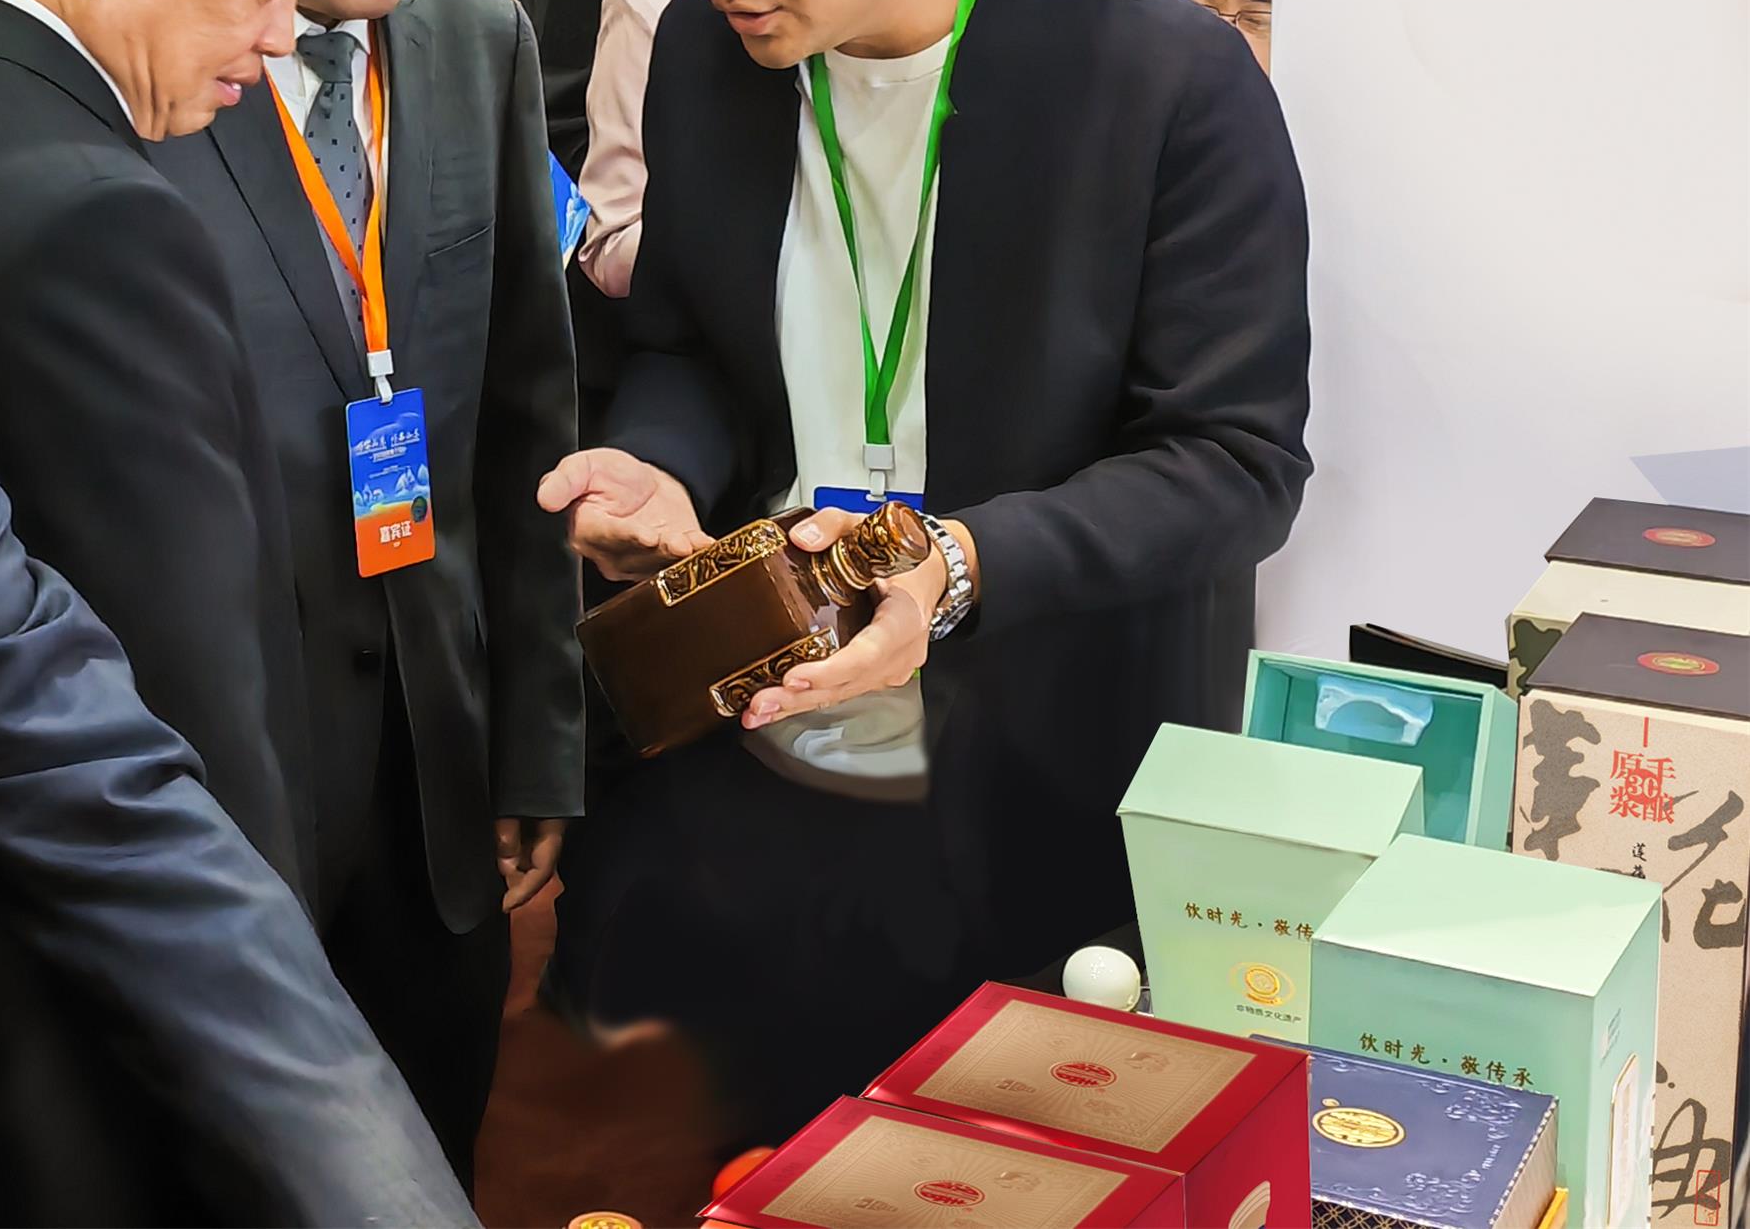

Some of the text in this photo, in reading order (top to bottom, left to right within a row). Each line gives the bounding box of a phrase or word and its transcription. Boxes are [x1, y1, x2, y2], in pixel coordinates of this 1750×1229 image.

[1359, 1032, 1534, 1087] 饮时光·敬传承
